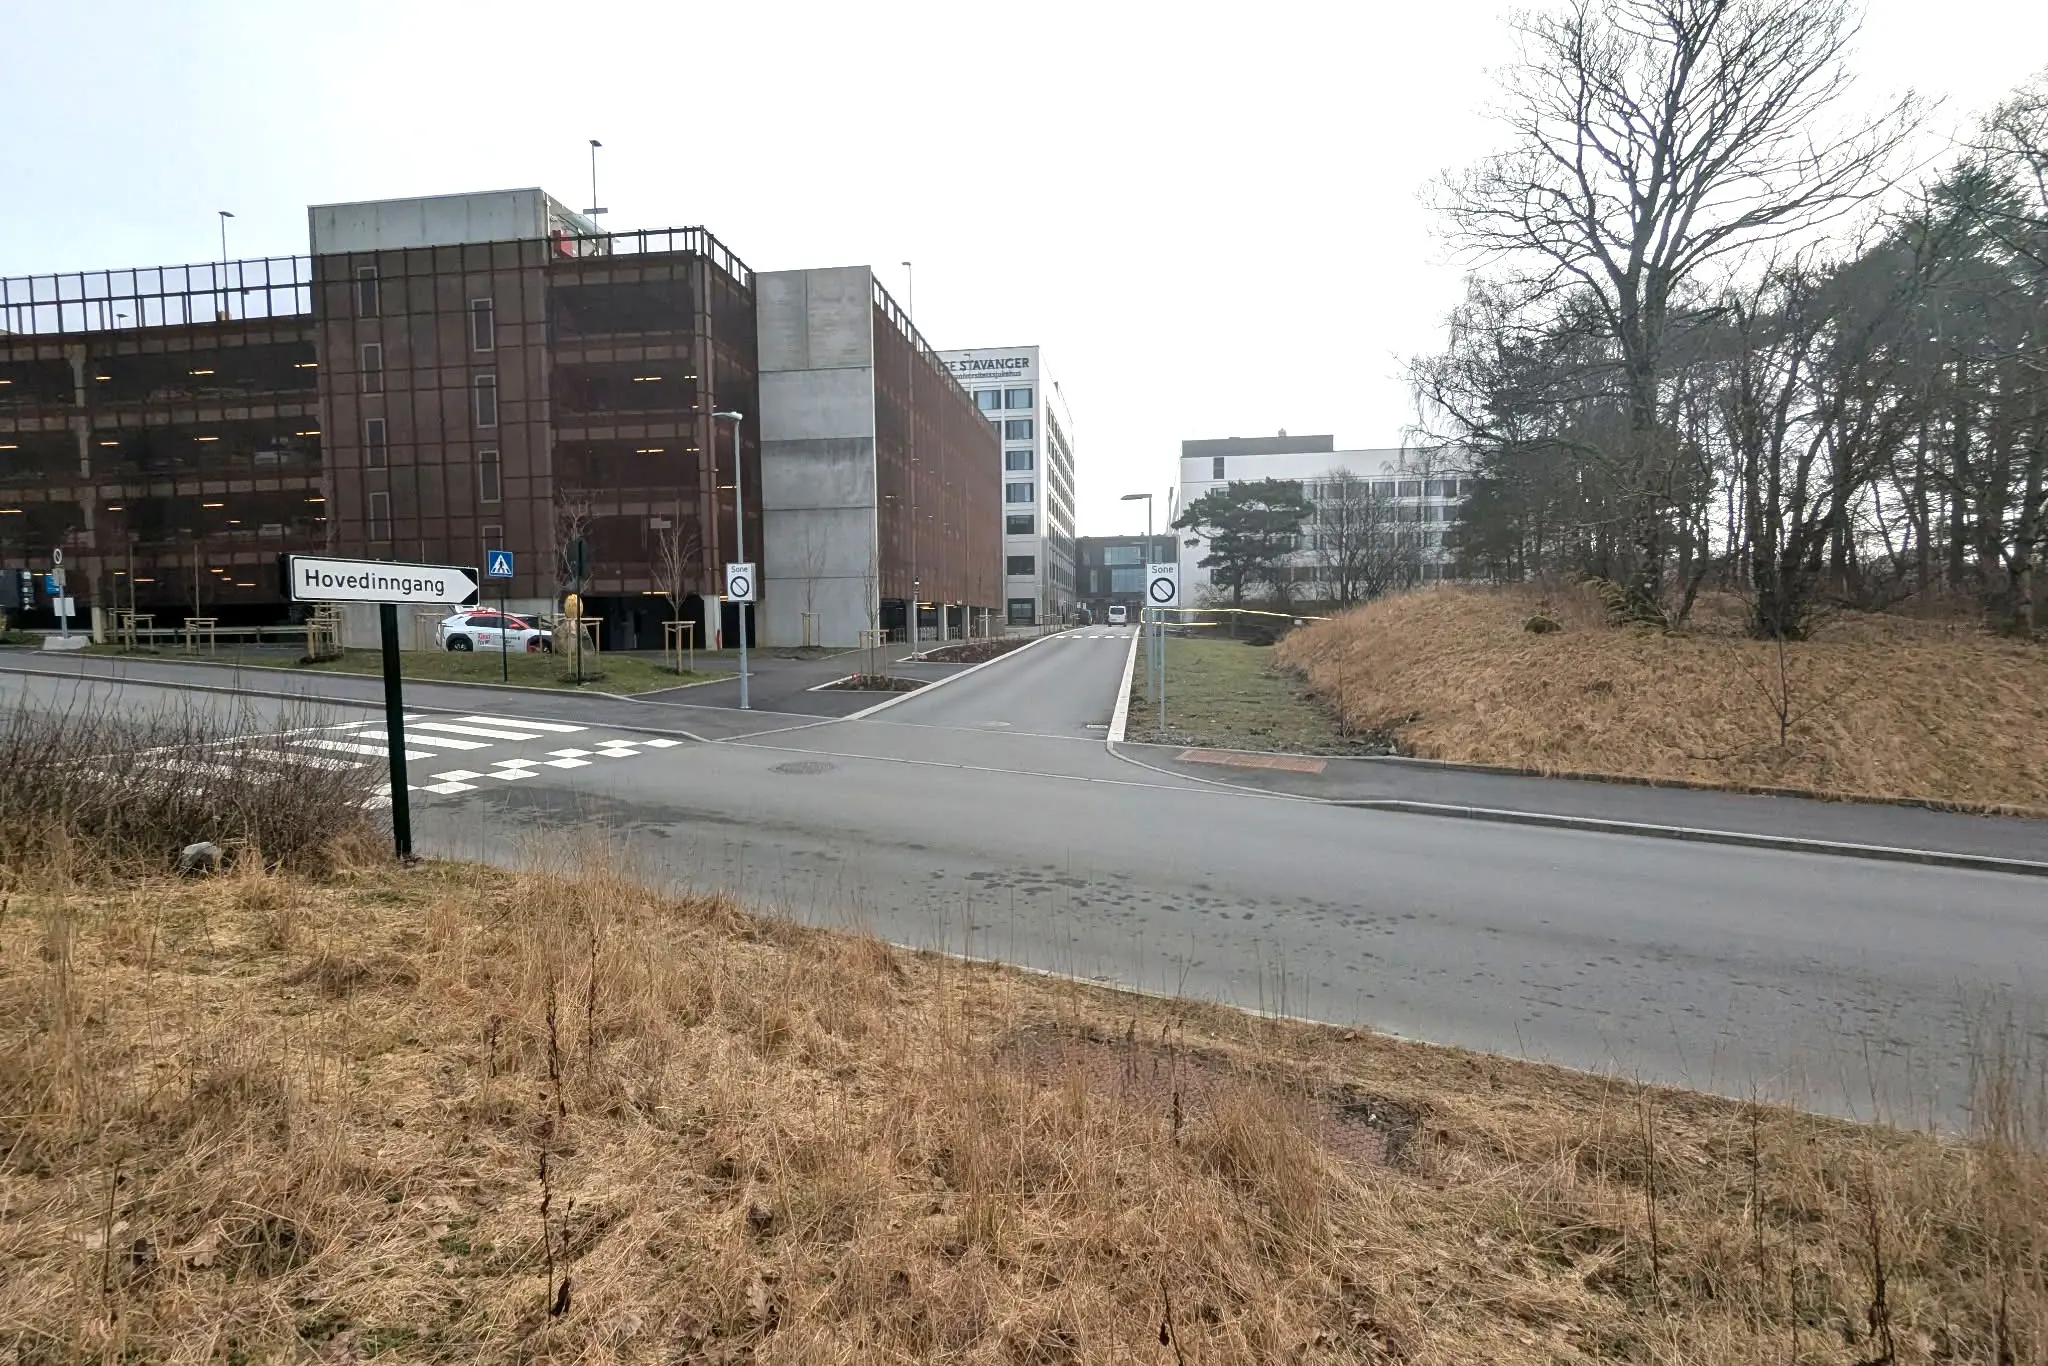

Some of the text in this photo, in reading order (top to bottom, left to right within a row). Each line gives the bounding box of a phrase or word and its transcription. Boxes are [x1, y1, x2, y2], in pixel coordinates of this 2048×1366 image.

[959, 357, 1029, 371] STAVANGER
[731, 565, 748, 573] Sone
[1151, 565, 1174, 573] Sone
[305, 569, 445, 596] Hovedinngang
